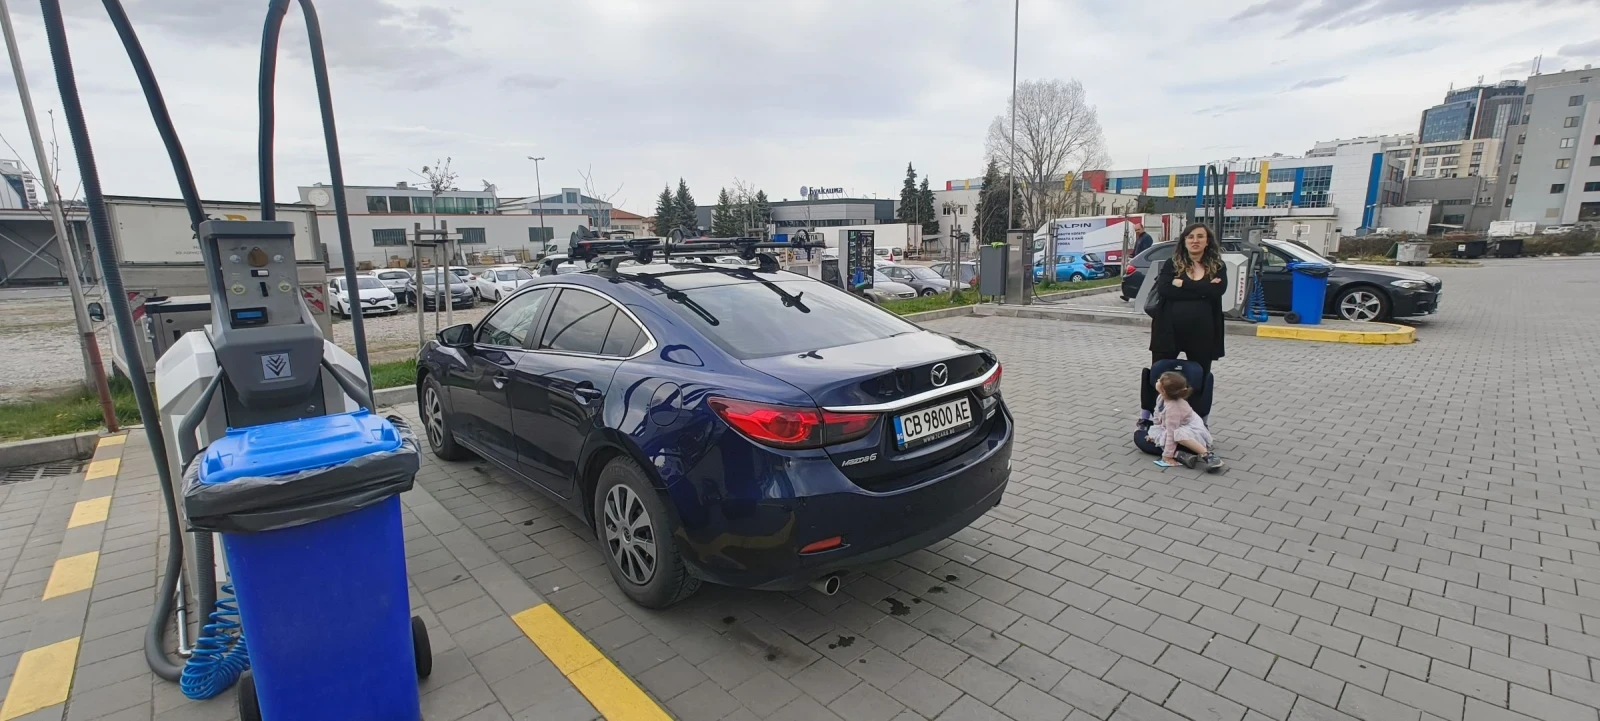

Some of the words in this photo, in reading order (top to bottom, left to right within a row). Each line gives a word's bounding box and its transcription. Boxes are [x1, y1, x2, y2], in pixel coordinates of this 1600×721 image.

[904, 414, 922, 437] CB
[923, 405, 953, 432] 9800
[955, 401, 970, 422] AE
